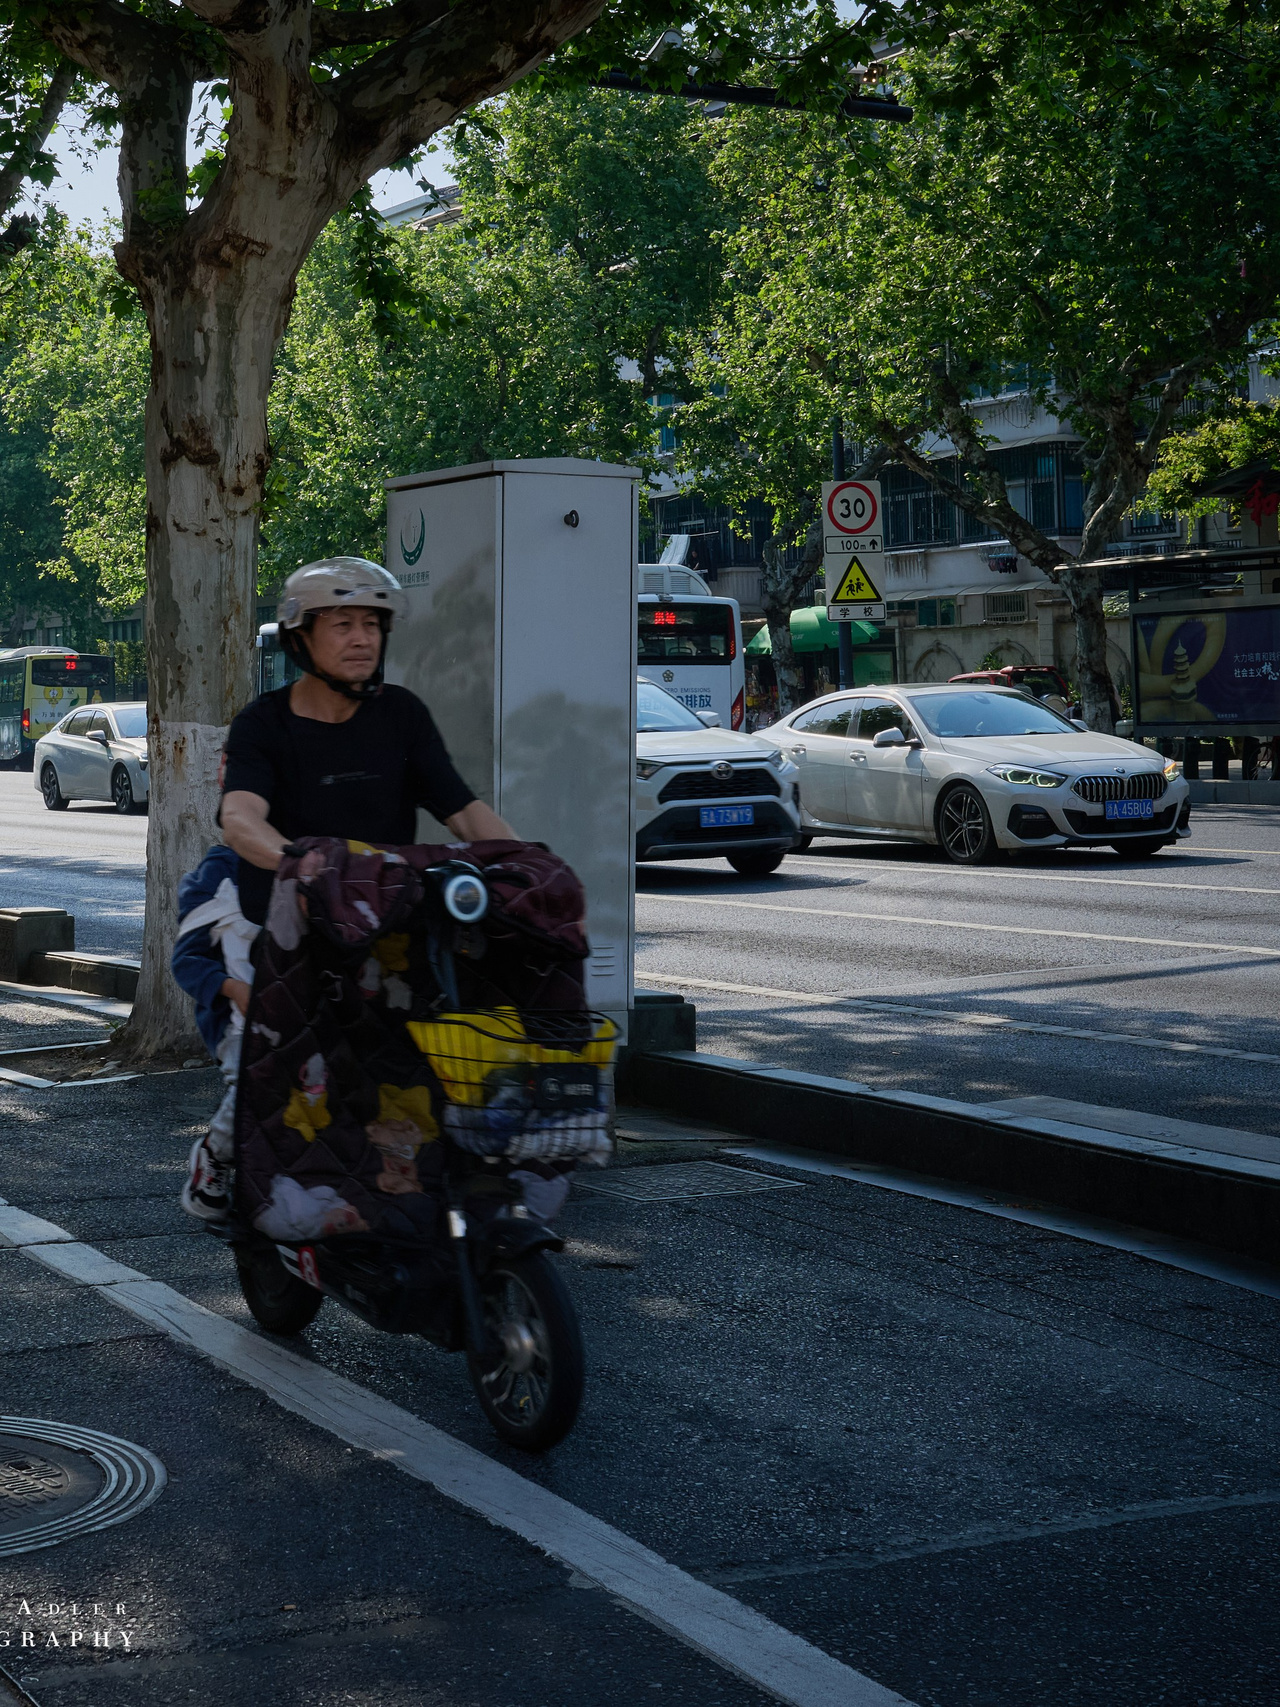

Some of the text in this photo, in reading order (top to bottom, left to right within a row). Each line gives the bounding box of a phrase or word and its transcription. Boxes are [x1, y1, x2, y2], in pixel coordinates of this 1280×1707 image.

[840, 498, 865, 518] 30
[841, 540, 866, 551] 100m
[839, 606, 873, 618] 学校
